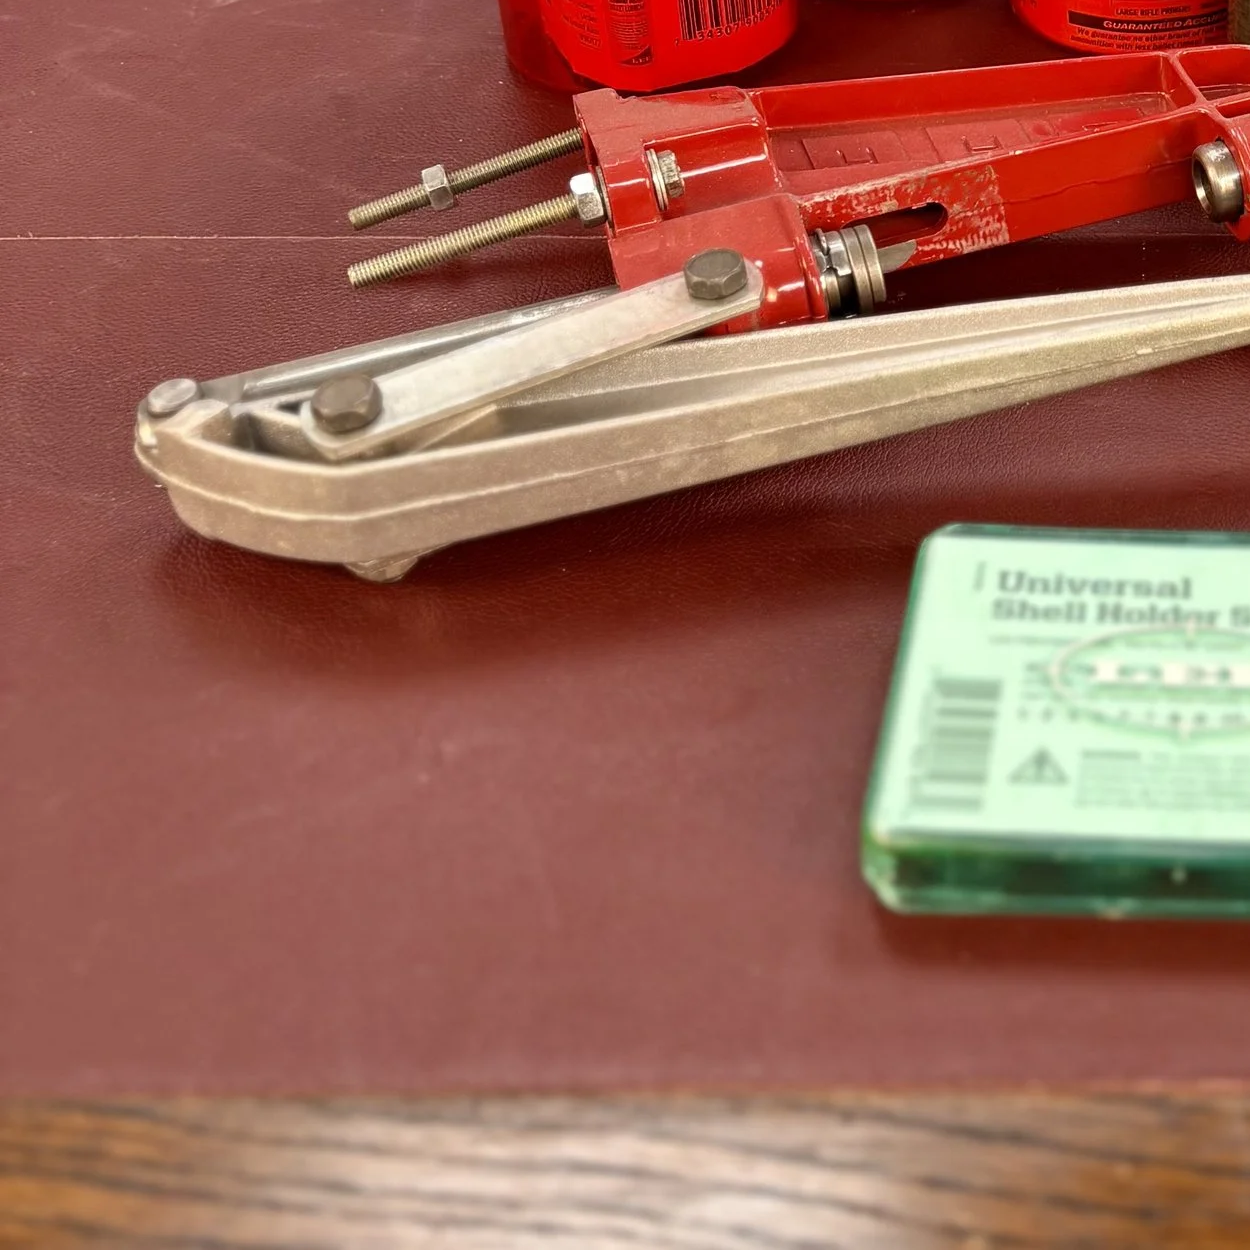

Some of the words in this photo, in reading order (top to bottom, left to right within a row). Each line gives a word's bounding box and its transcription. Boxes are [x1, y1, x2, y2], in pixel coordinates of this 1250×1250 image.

[1103, 19, 1182, 30] GUARANTEED
[997, 570, 1193, 599] Universal
[991, 598, 1087, 624] Shell
[1096, 601, 1219, 626] Holder
